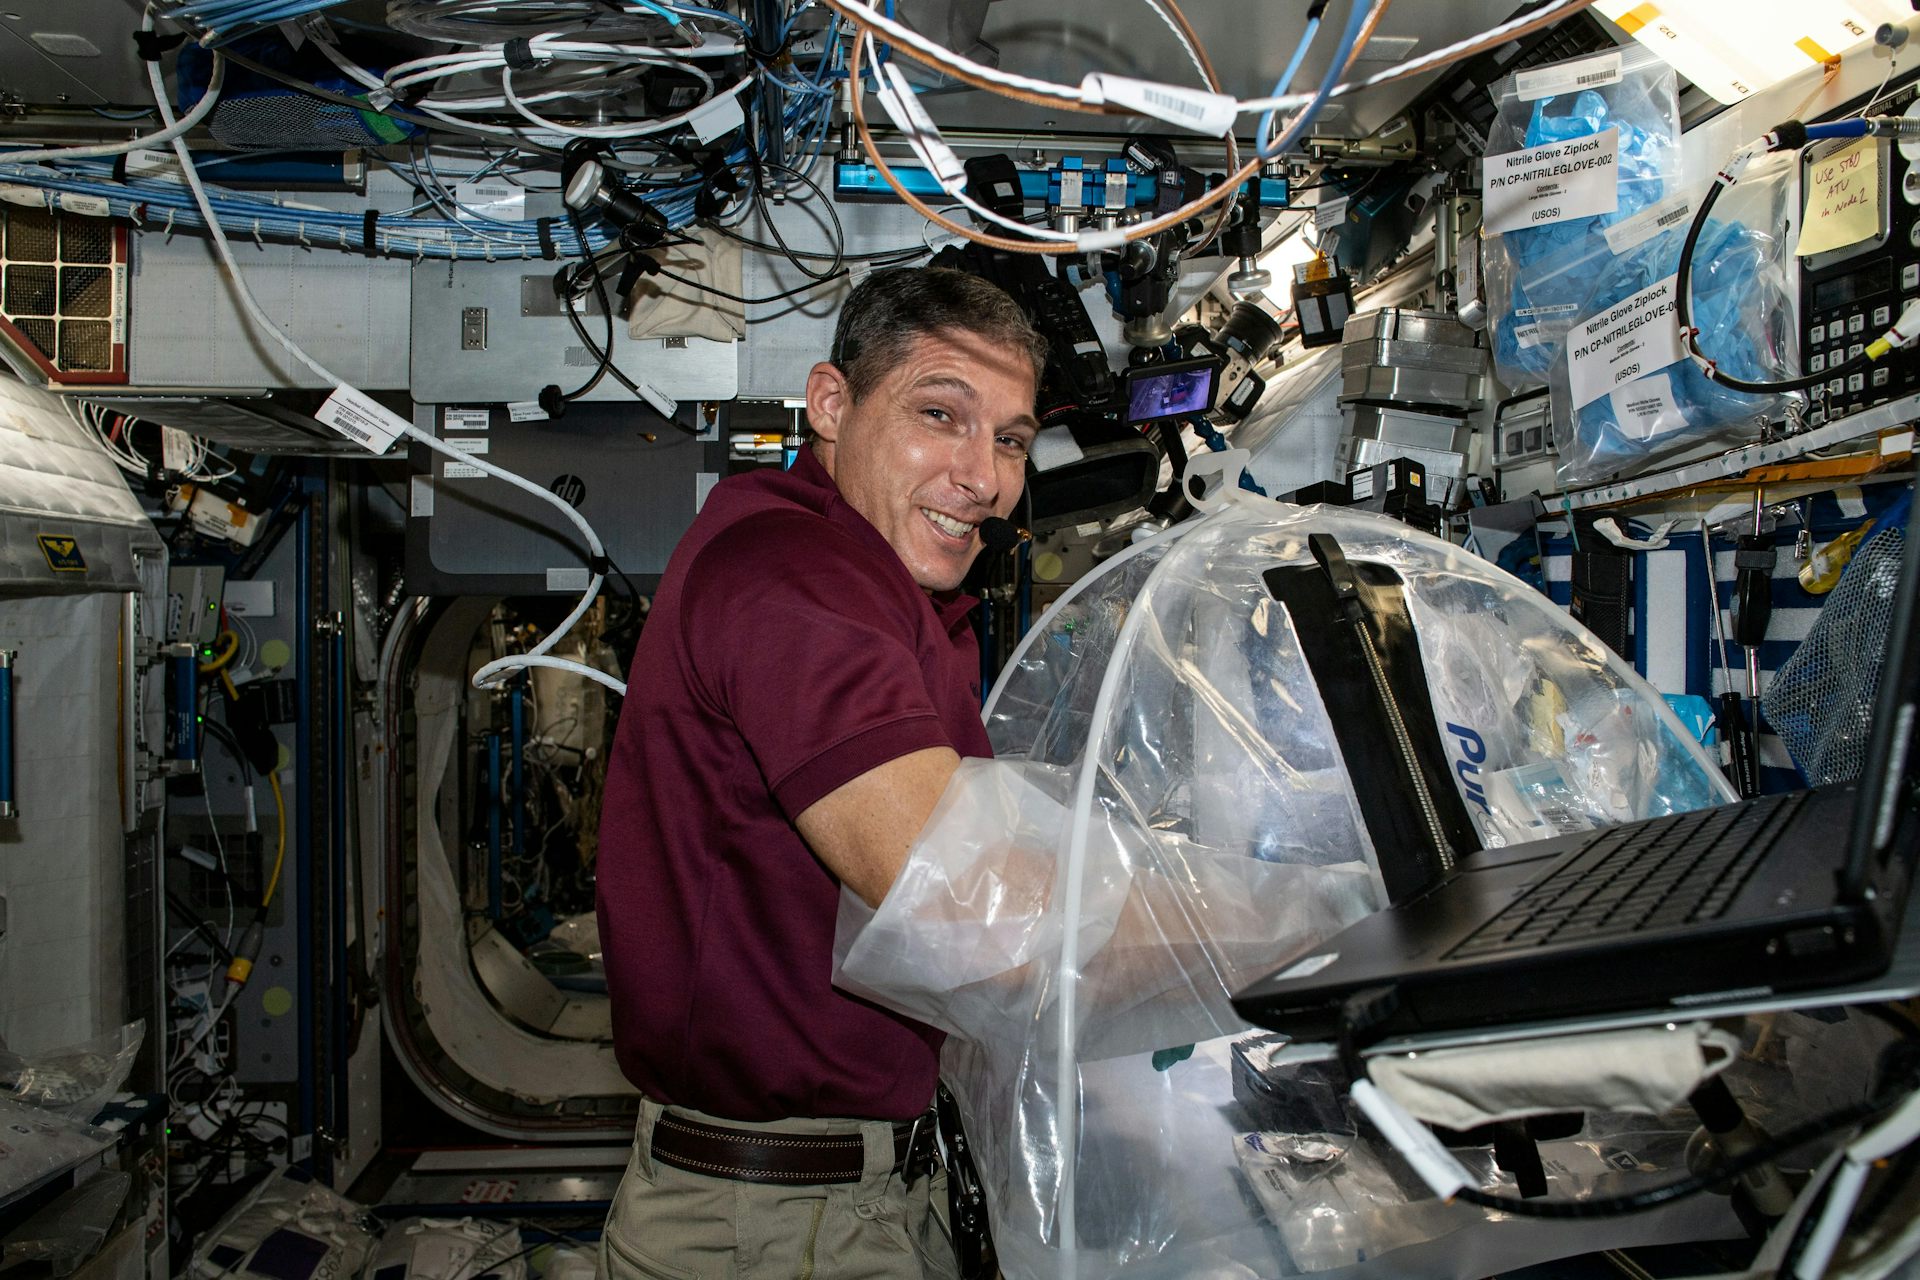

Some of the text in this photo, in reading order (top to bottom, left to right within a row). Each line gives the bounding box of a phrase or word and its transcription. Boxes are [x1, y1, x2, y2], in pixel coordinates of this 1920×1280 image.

[1659, 24, 1677, 40] D2
[1844, 19, 1864, 36] D4
[1732, 80, 1749, 94] D1
[1506, 140, 1600, 168] Nitrile Glove Ziplock
[1490, 154, 1612, 188] P/N CP-NITRILEGLOVE-002
[1532, 207, 1560, 222] (USOS)
[1586, 285, 1667, 335] Nitrile Glove Ziplock
[1574, 346, 1589, 360] P/N
[1614, 362, 1640, 383] (USOS)
